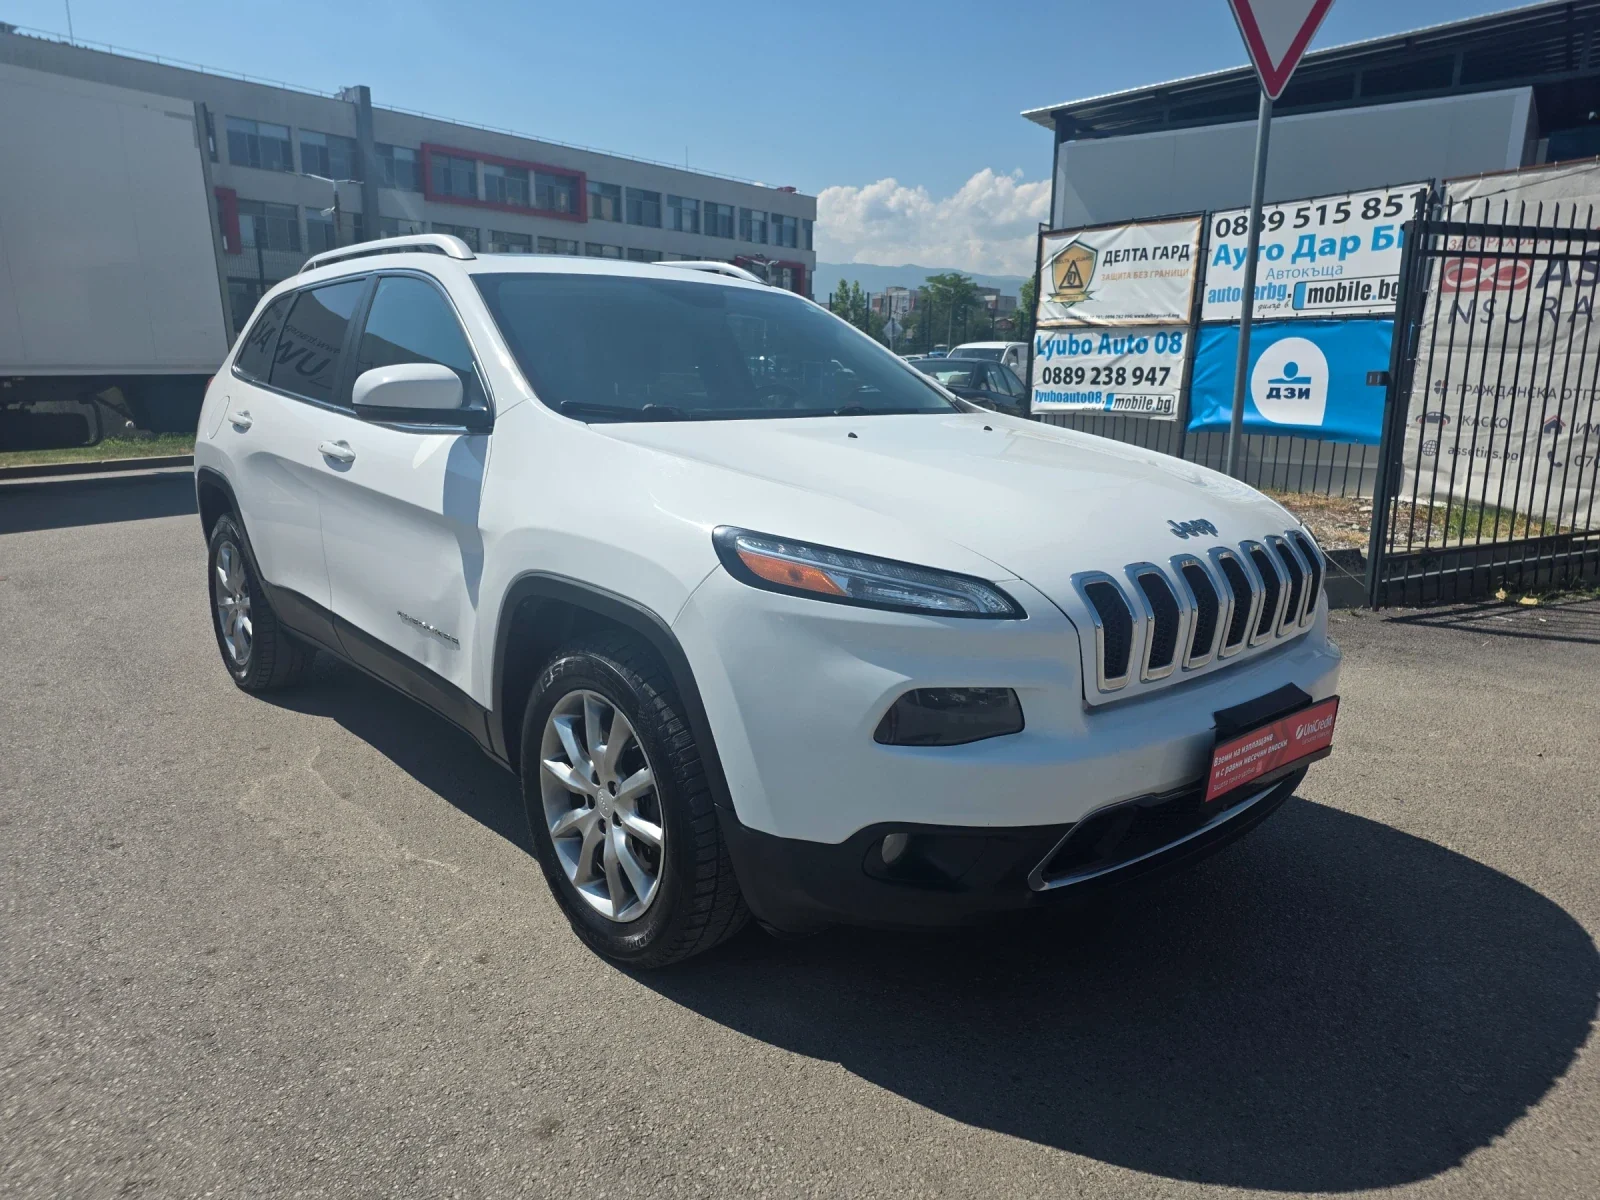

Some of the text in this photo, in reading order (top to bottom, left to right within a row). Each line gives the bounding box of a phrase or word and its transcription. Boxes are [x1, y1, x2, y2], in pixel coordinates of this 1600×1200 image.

[1293, 201, 1351, 229] 515
[1103, 244, 1190, 267] ДЕЛТА ГАРД
[1291, 233, 1361, 264] Дар
[1101, 268, 1189, 282] ЗАЩИТА БЕЗ ГРАНИЦИ
[1266, 264, 1343, 280] Автокъща
[1208, 282, 1291, 304] autoarbg.
[1307, 279, 1399, 304] mobile.bg
[1037, 331, 1183, 361] Lyubo Auto 08
[1042, 366, 1171, 386] 0889 238 947
[1113, 394, 1172, 413] mobile.bg
[1266, 387, 1311, 400] ДЗИ
[1462, 415, 1509, 429] КАСКО
[1304, 714, 1333, 737] UniCredit
